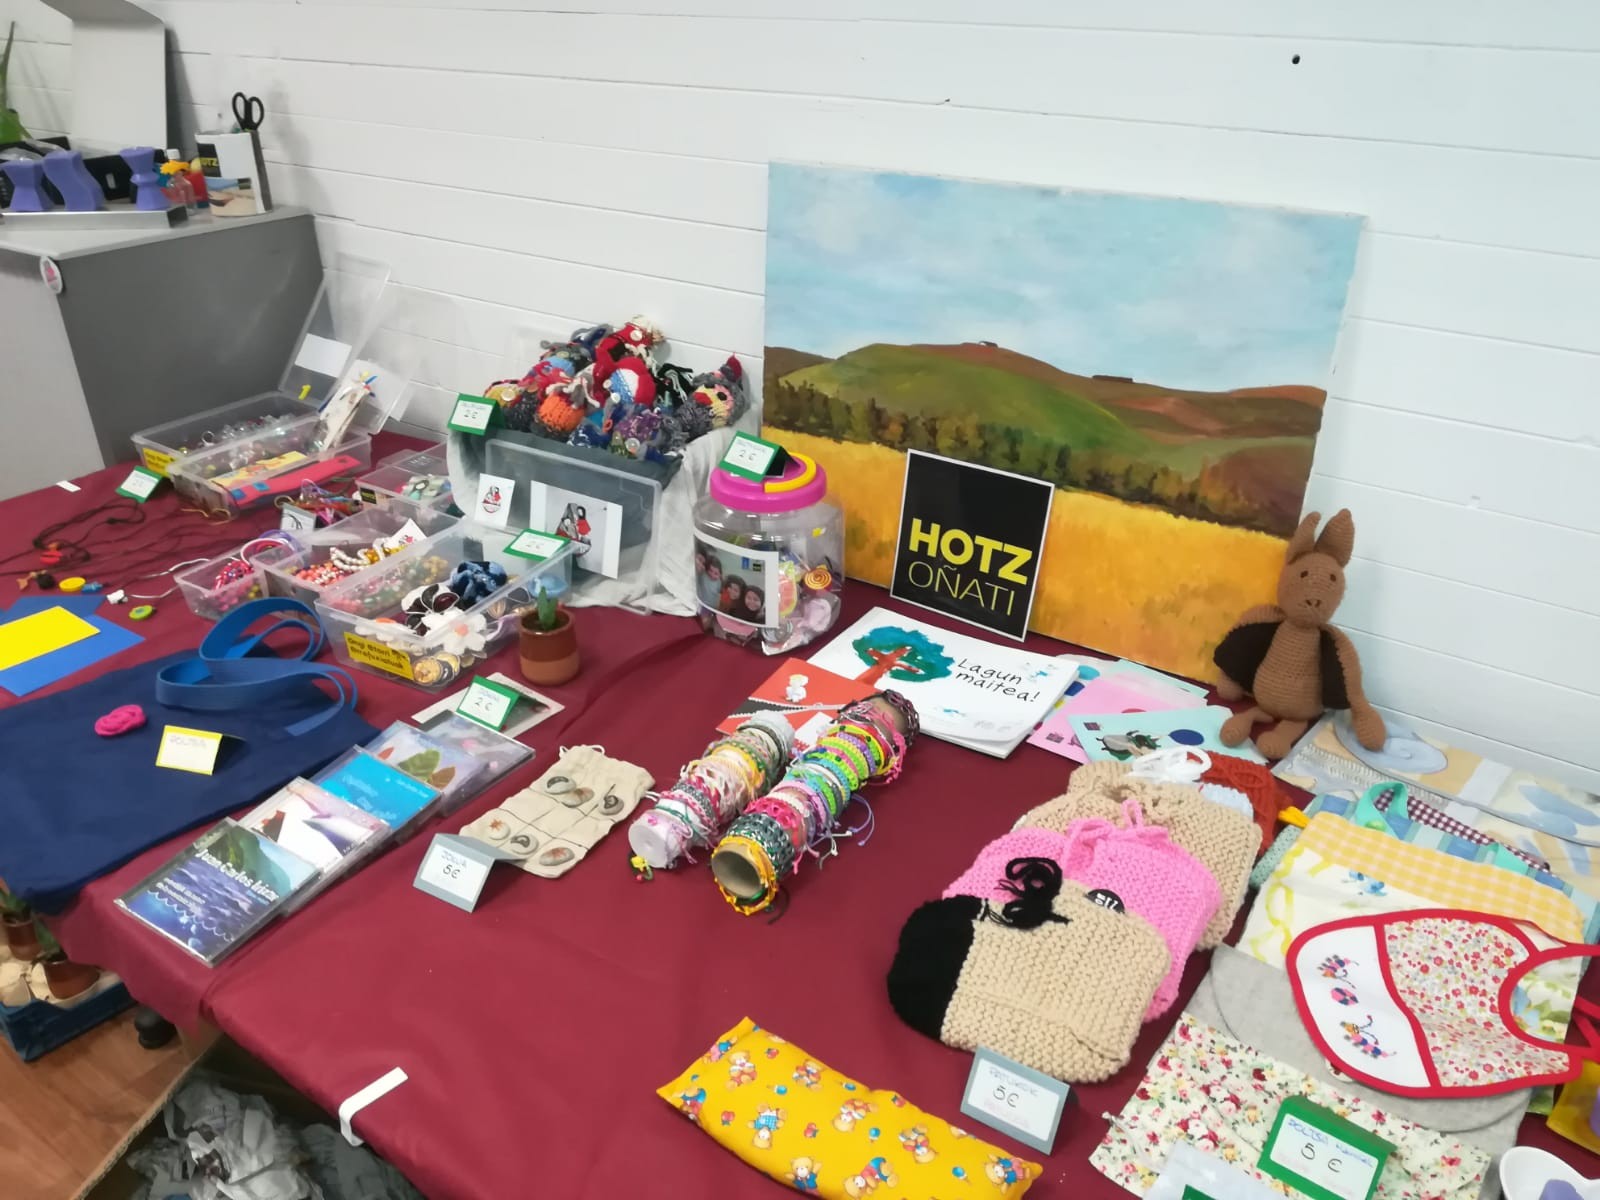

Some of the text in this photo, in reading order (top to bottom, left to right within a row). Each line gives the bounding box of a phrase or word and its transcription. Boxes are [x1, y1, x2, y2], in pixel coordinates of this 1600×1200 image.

[908, 517, 1033, 586] HOTZ
[908, 561, 1015, 616] OÑATI
[955, 672, 1041, 703] maitea!
[957, 658, 1022, 685] Lagun
[195, 849, 223, 871] Juan
[220, 861, 254, 888] Carlos
[250, 879, 280, 902] Irizar
